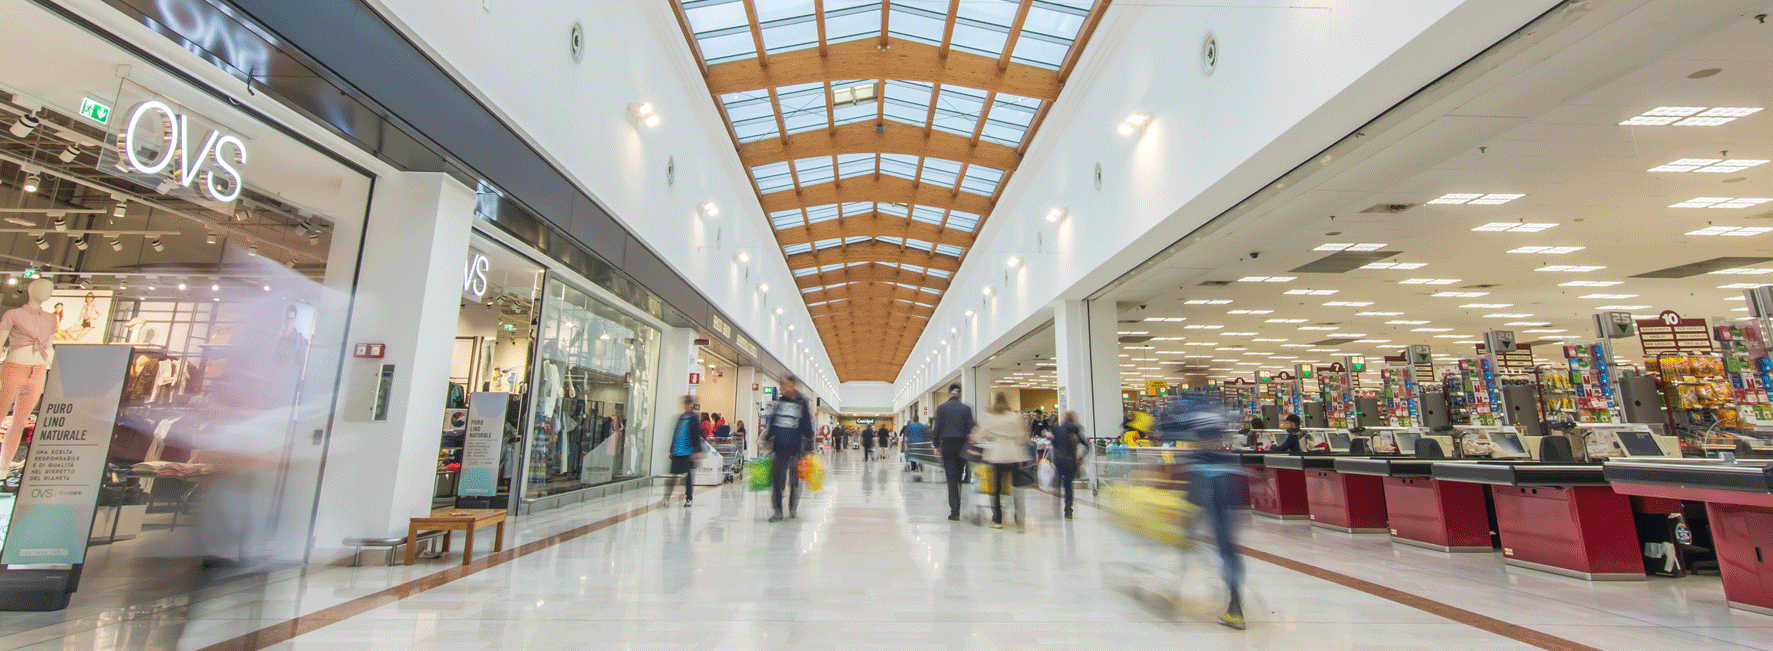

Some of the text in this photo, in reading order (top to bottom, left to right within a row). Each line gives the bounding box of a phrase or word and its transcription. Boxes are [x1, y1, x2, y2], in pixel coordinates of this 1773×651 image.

[125, 100, 247, 202] OVS
[463, 254, 489, 296] VS
[1611, 313, 1630, 323] 25
[1662, 313, 1679, 325] 10
[1496, 332, 1513, 340] 24
[1416, 346, 1430, 354] 23
[46, 403, 73, 414] PURO
[43, 416, 65, 427] LINO
[40, 429, 88, 440] NATURALE
[31, 488, 53, 498] OVS
